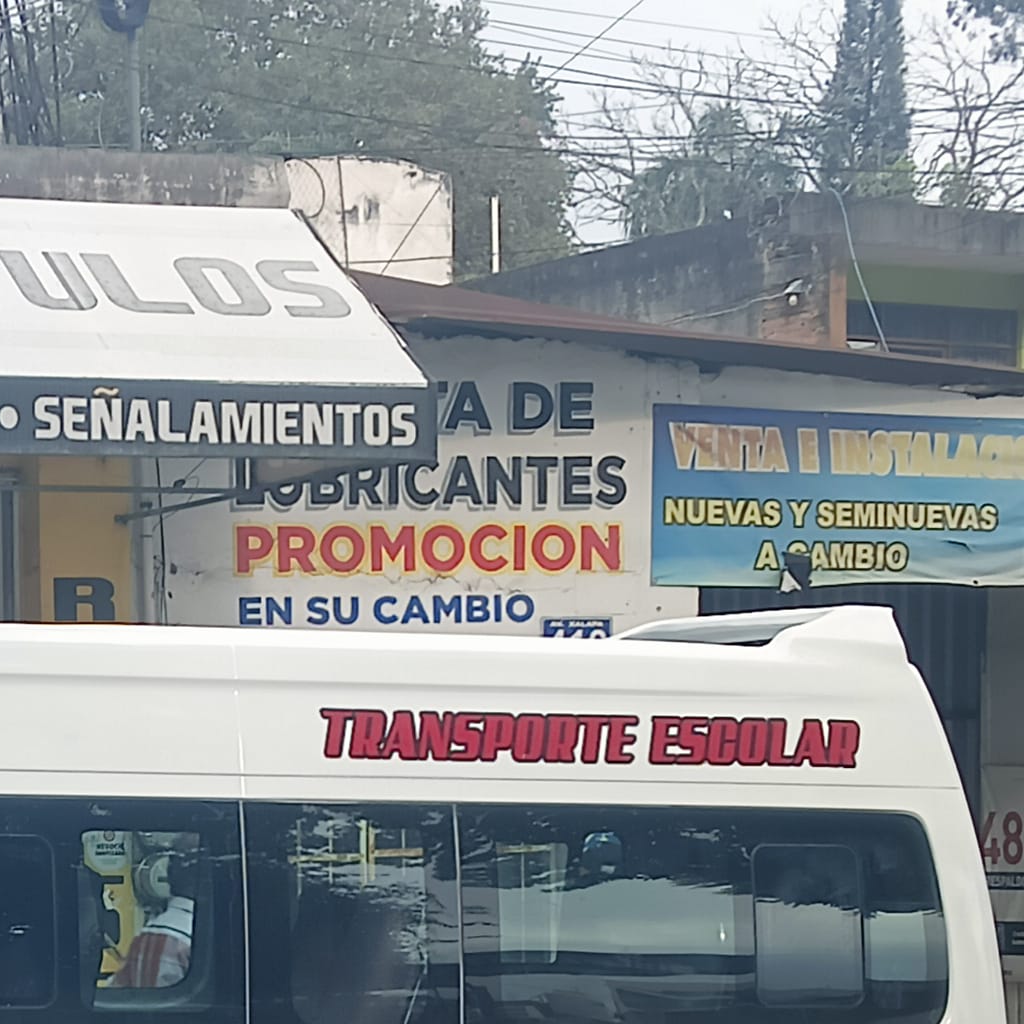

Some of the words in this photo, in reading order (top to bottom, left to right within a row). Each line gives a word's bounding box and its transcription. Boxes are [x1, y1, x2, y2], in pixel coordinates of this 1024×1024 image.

[33, 386, 418, 447] SEÑALAMIENTOS
[511, 381, 595, 431] DE
[668, 421, 790, 473] VENTA
[828, 428, 1024, 481] INSTALACI
[663, 498, 782, 528] NUEVAS
[787, 500, 812, 527] Y
[816, 501, 999, 532] SEMINUEVAS
[234, 523, 623, 576] PROMOCION
[754, 540, 780, 571] A
[239, 597, 293, 625] EN
[307, 597, 360, 626] SU
[373, 594, 536, 625] CAMBIO
[320, 708, 639, 763] TRANSPORTE
[648, 715, 860, 768] ESCOLAR
